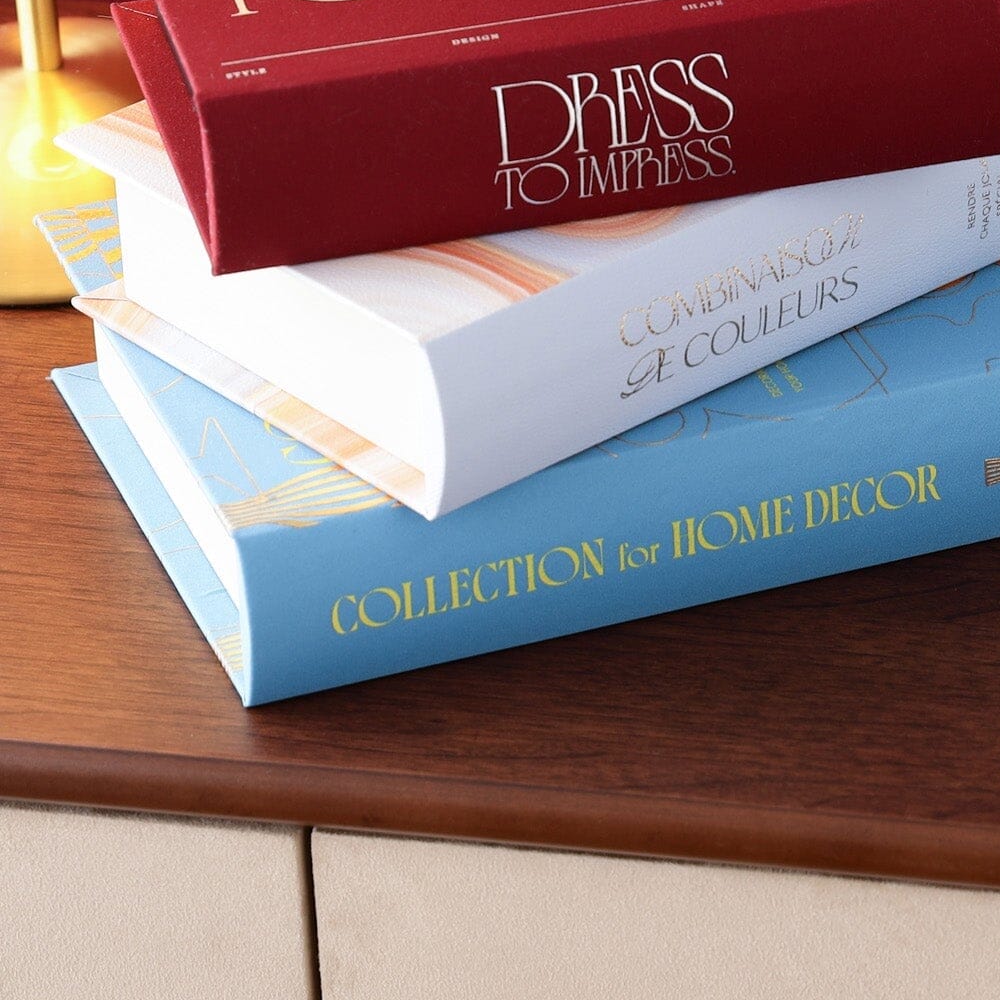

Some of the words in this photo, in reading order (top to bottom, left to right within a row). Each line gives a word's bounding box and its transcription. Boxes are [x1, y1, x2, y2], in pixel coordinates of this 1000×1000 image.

[681, 0, 724, 11] SHAPE
[451, 33, 500, 46] DESIGN
[225, 67, 268, 80] STYLE
[490, 52, 735, 167] DRESS
[494, 162, 570, 211] TO
[577, 134, 737, 199] IMPRESS.
[966, 183, 977, 230] RENDRE
[980, 190, 993, 240] CHAQUE
[684, 265, 859, 368] COULEURS
[330, 537, 605, 636] COLLECTION
[618, 542, 661, 574] for
[672, 496, 795, 560] HOME
[804, 463, 943, 530] DECOR
